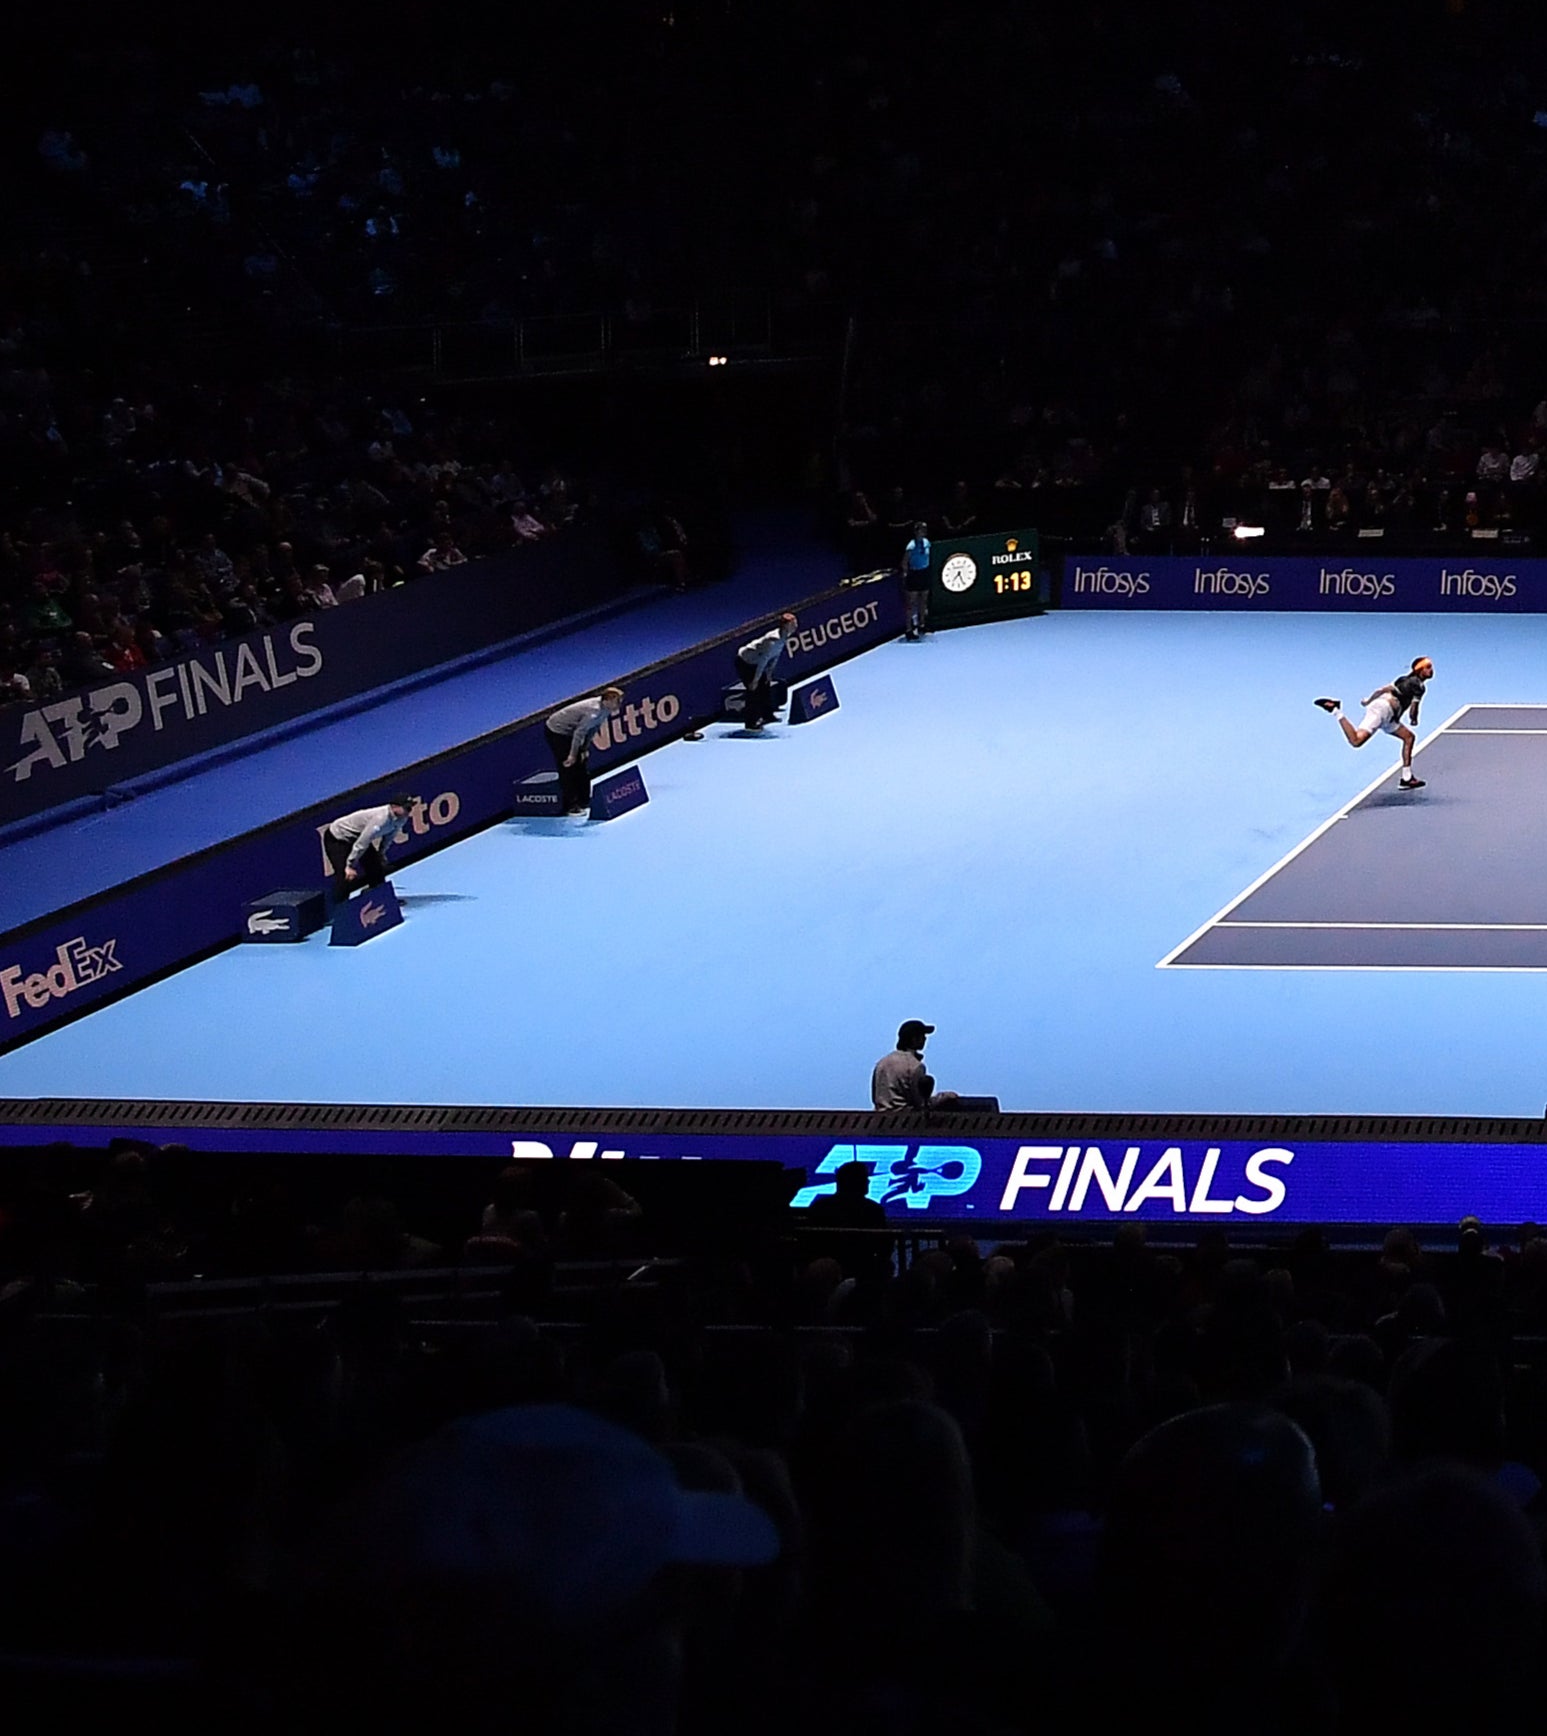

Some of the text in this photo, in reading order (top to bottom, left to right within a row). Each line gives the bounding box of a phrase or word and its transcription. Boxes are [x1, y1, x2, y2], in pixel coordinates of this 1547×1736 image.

[992, 551, 1032, 565] ROLEX
[994, 571, 1031, 595] 1:13
[1074, 567, 1150, 598] Infosys
[1194, 567, 1270, 599] Infosys
[1319, 568, 1395, 599] Infosys
[1440, 569, 1517, 601] Infosys
[786, 601, 879, 659] PEUGEOT
[14, 622, 323, 782] ATP FINALS
[516, 795, 558, 804] LACOSTE
[0, 936, 124, 1018] FedEx
[998, 1146, 1294, 1214] FINALS
